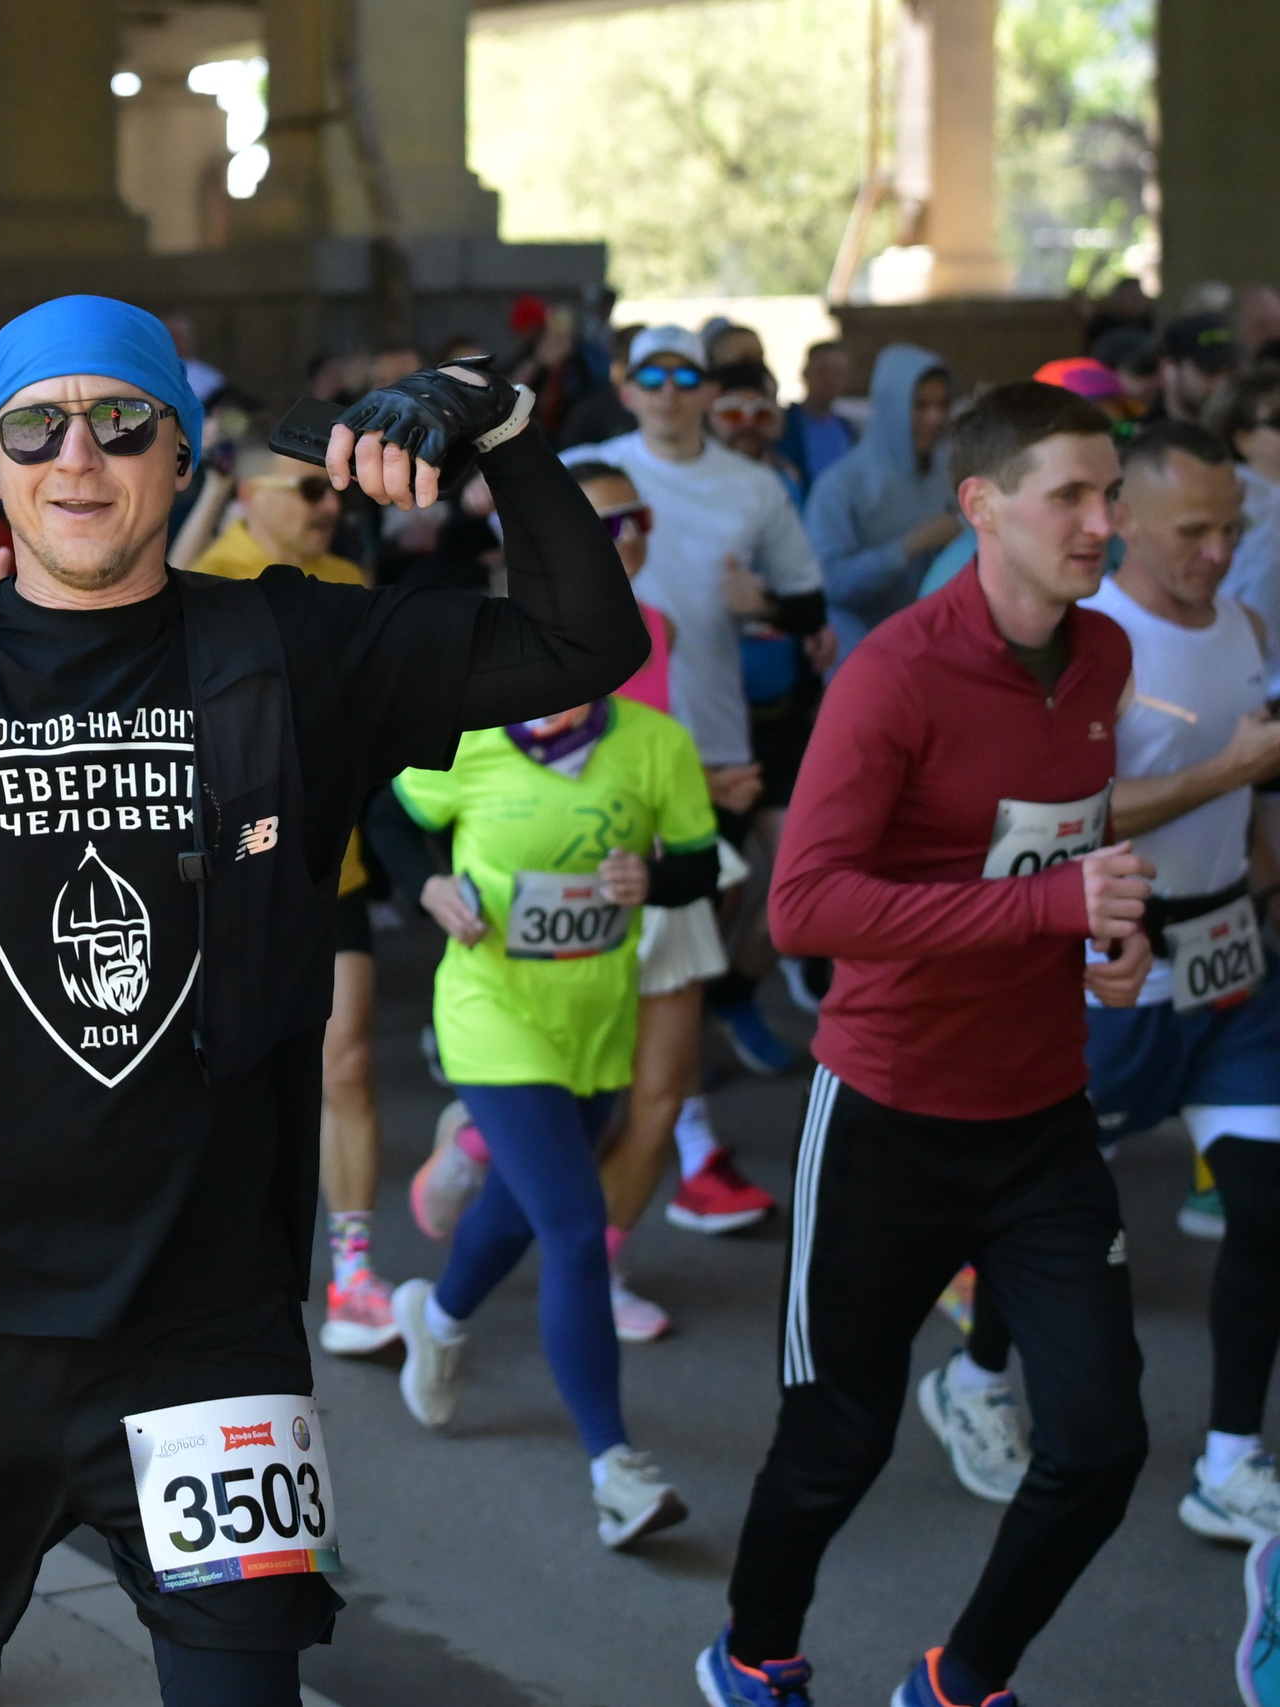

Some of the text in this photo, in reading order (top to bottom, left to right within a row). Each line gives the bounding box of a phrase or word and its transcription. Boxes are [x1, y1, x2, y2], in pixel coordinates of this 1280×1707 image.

[521, 906, 617, 944] 3007
[81, 1024, 138, 1048] ДОН
[163, 1462, 326, 1553] 3503
